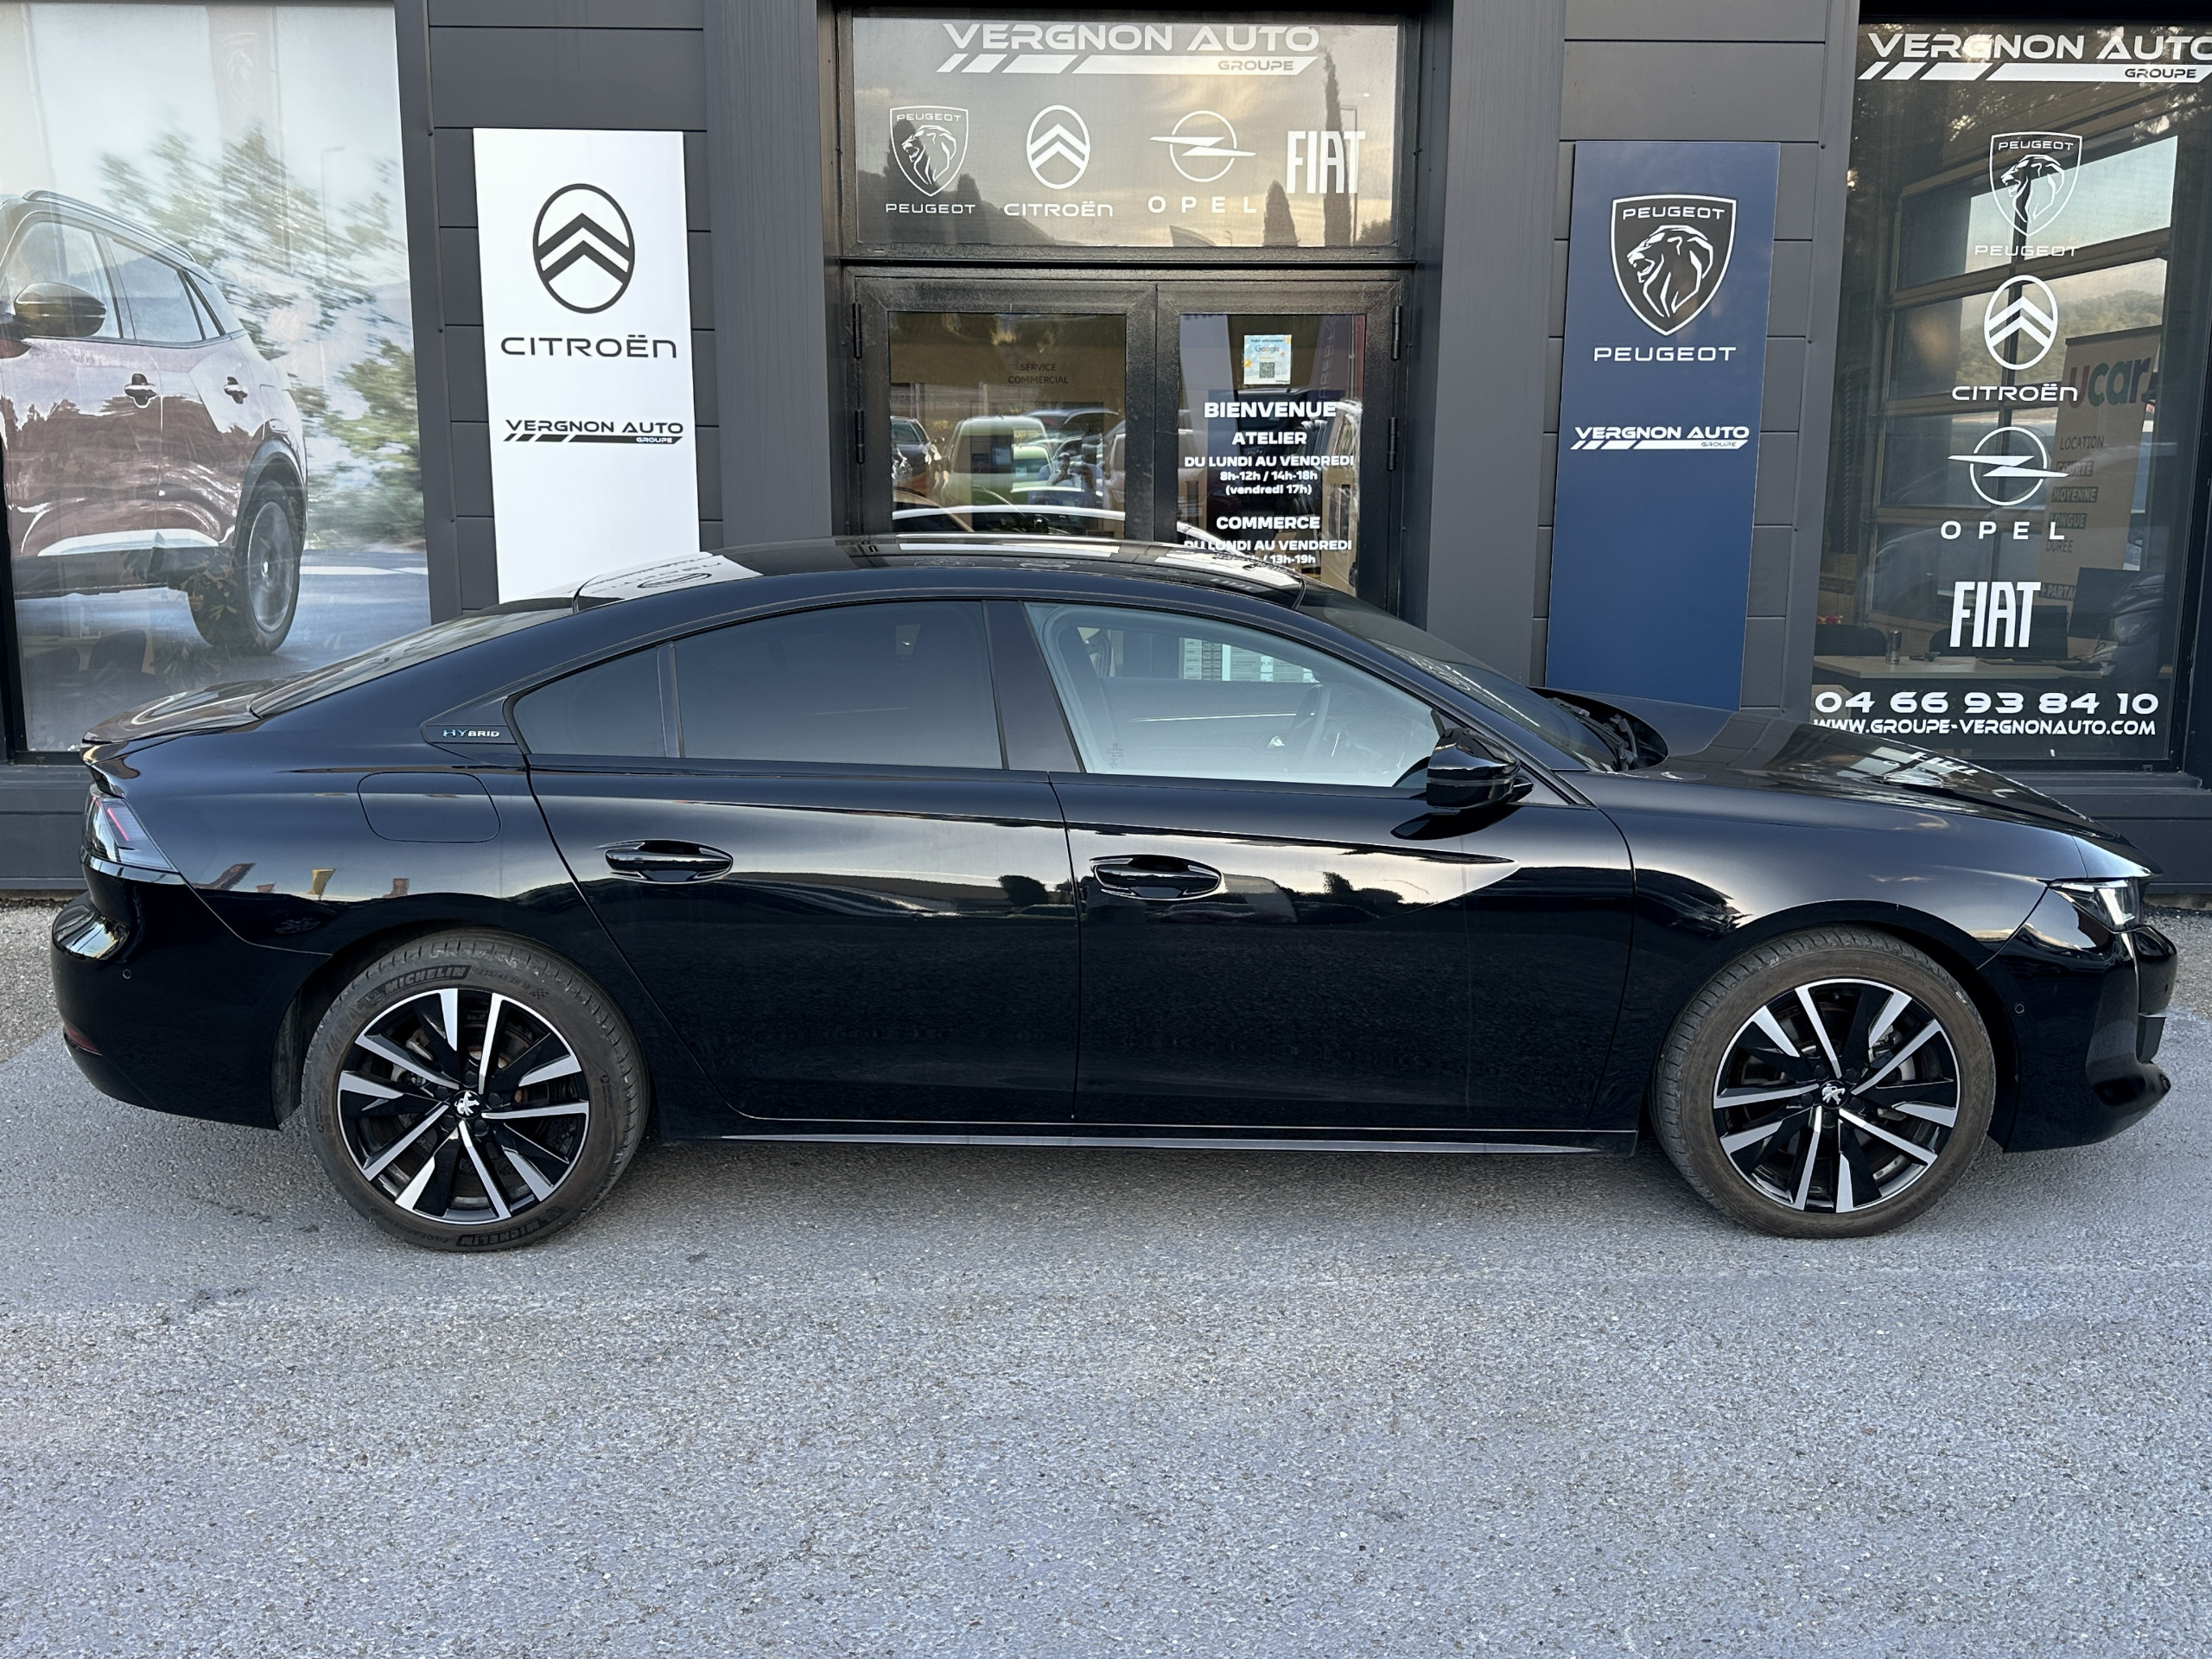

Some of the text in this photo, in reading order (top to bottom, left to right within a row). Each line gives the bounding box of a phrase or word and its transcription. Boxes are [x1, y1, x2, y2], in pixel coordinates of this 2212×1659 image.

[944, 23, 1319, 51] VERGNON AUTO
[1868, 33, 2212, 61] VERGNON AUTO
[1217, 60, 1294, 72] GROUPE
[2124, 67, 2197, 79] GROUPE
[896, 112, 962, 123] PEUGEOT
[1998, 140, 2074, 151] PEUGEOT
[1286, 130, 1366, 194] FIAT
[885, 203, 976, 214] PEUGEOT
[1147, 195, 1257, 213] OPEL
[1623, 206, 1726, 220] PEUGEOT
[1974, 245, 2082, 257] PEUGEOT
[1593, 346, 1737, 362] PEUGEOT
[1020, 363, 1057, 372] SERVICE
[1007, 375, 1070, 385] COMMERCIAL
[1204, 401, 1337, 418] BIENVENUE
[505, 419, 683, 434] VERGNON AUTO
[1574, 426, 1750, 440] VERGNON AUTO
[1231, 431, 1307, 445] ATELIER
[2059, 435, 2105, 450] LOCATION
[1185, 455, 1354, 467] DU LUNDI AU VENDREDI
[1220, 471, 1261, 481] 8h-12h
[1271, 471, 1318, 481] 14h-18h
[1286, 484, 1313, 495] 17h)
[2053, 487, 2097, 501] MOYENNE
[1216, 516, 1320, 530] COMMERCE
[1940, 520, 2065, 540] OPEL
[1254, 540, 1275, 550] AU
[1278, 540, 1352, 550] VENDREDI
[1270, 555, 1316, 564] 13h-19h
[1949, 581, 2042, 648] FIAT
[1815, 691, 2159, 715] 04 66 93 84 10
[442, 728, 500, 738] HYBRID
[384, 965, 467, 992] MICHELIN
[461, 1218, 541, 1246] MICHELIN
